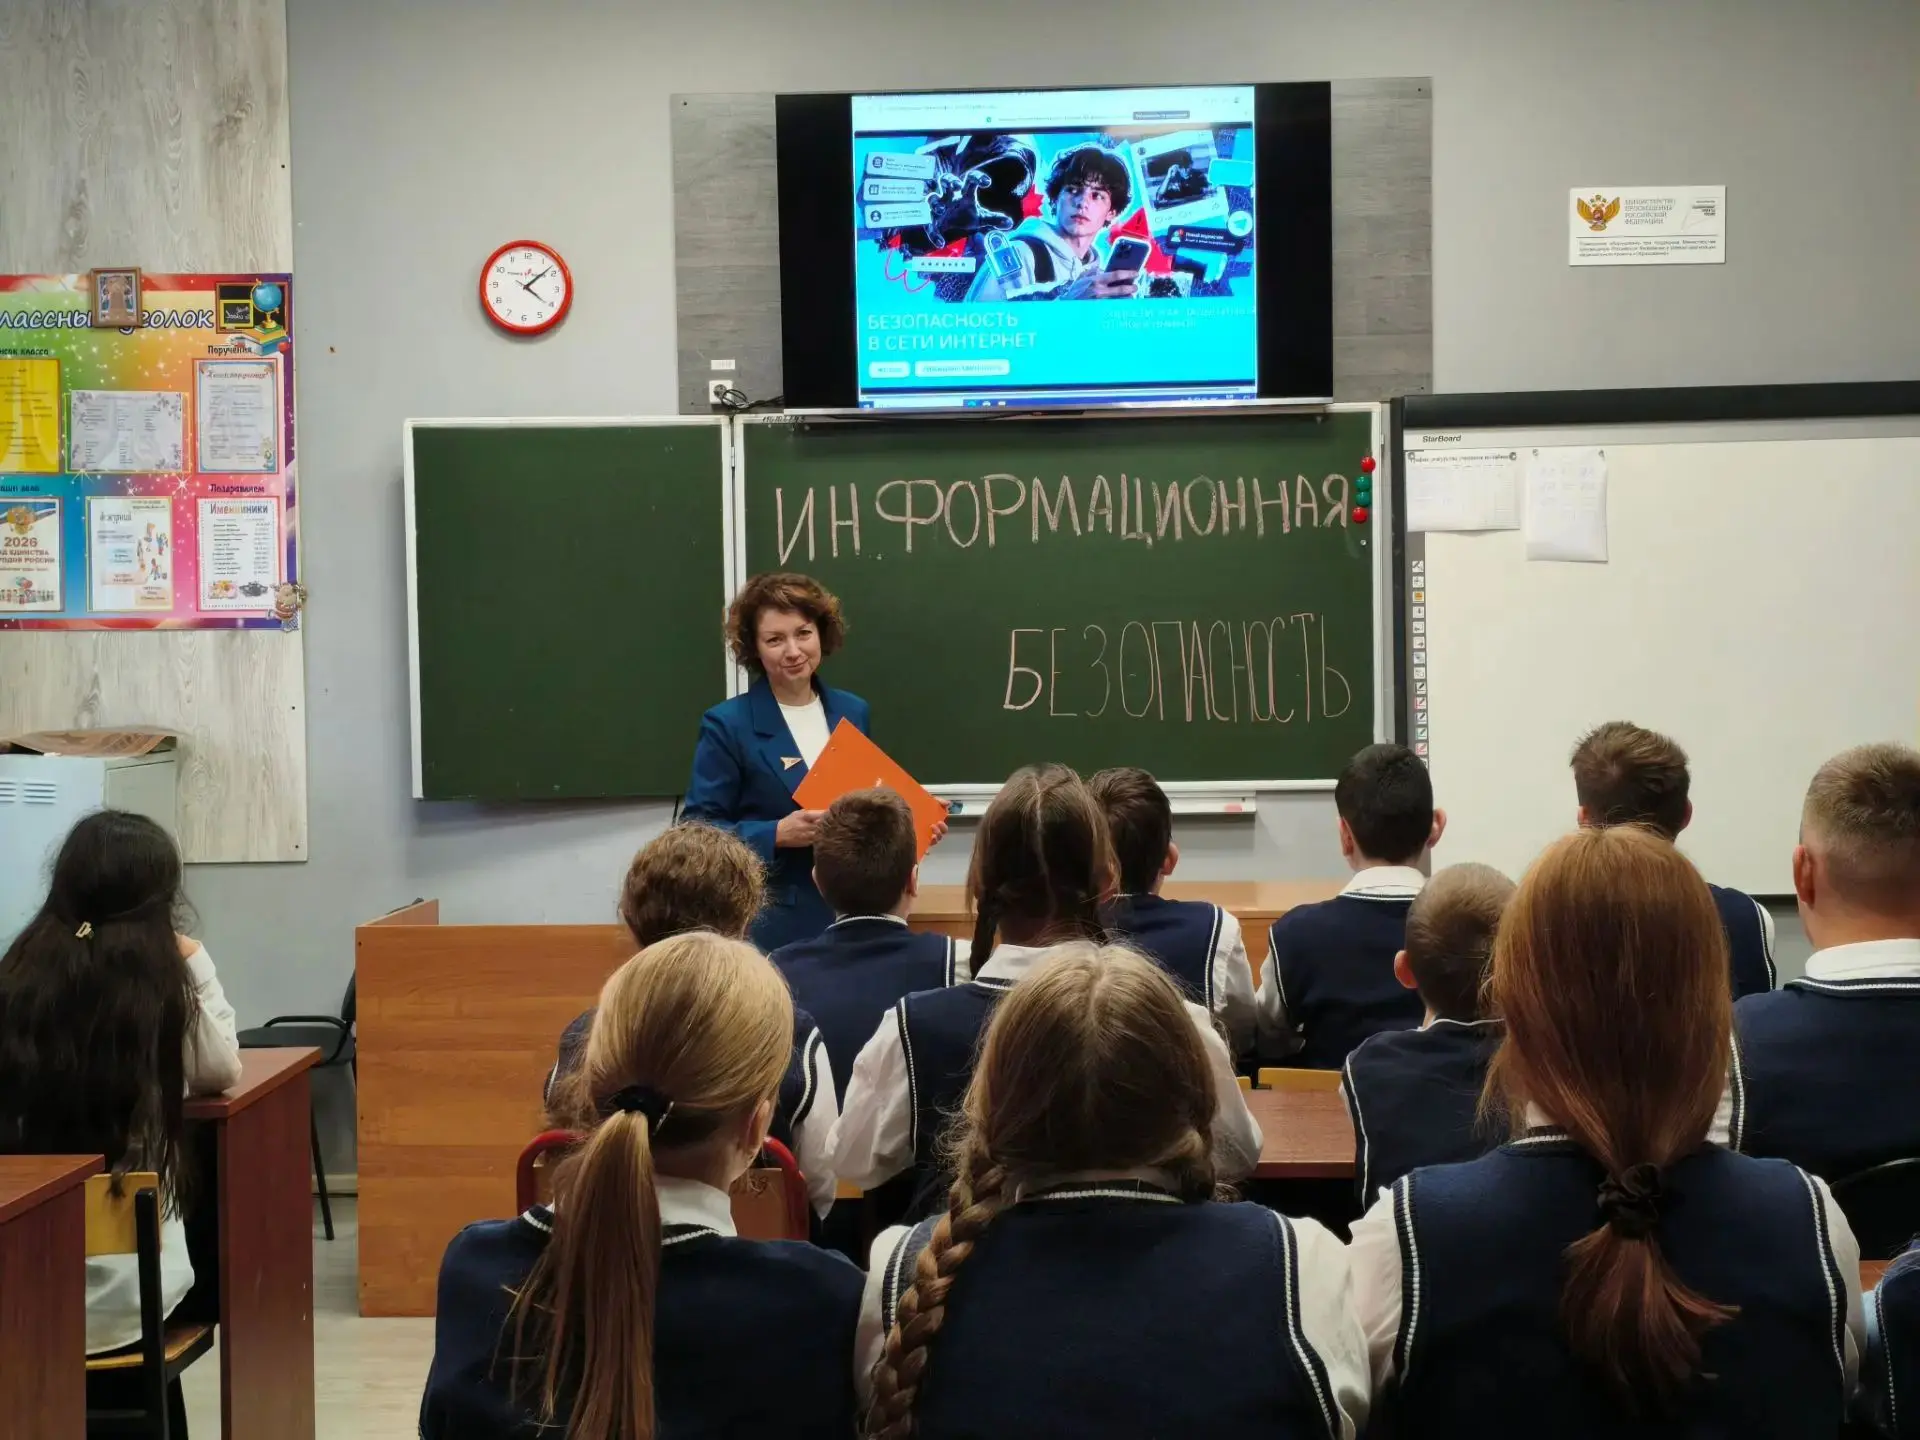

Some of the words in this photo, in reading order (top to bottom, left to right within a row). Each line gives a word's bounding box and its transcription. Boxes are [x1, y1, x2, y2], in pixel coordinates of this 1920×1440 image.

[0, 310, 92, 328] лассны
[867, 312, 1019, 330] БЕЗОПАСНОСТЬ
[867, 336, 880, 350] В
[885, 334, 934, 350] СЕТИ
[939, 332, 1037, 349] ИНТЕРНЕТ
[1422, 434, 1462, 443] StarBoard
[775, 473, 1349, 566] ИНФОРМАЦИОННАЯ
[4, 536, 38, 548] 2026
[1002, 612, 1352, 723] БЕЗОПАСНОСТЬ
